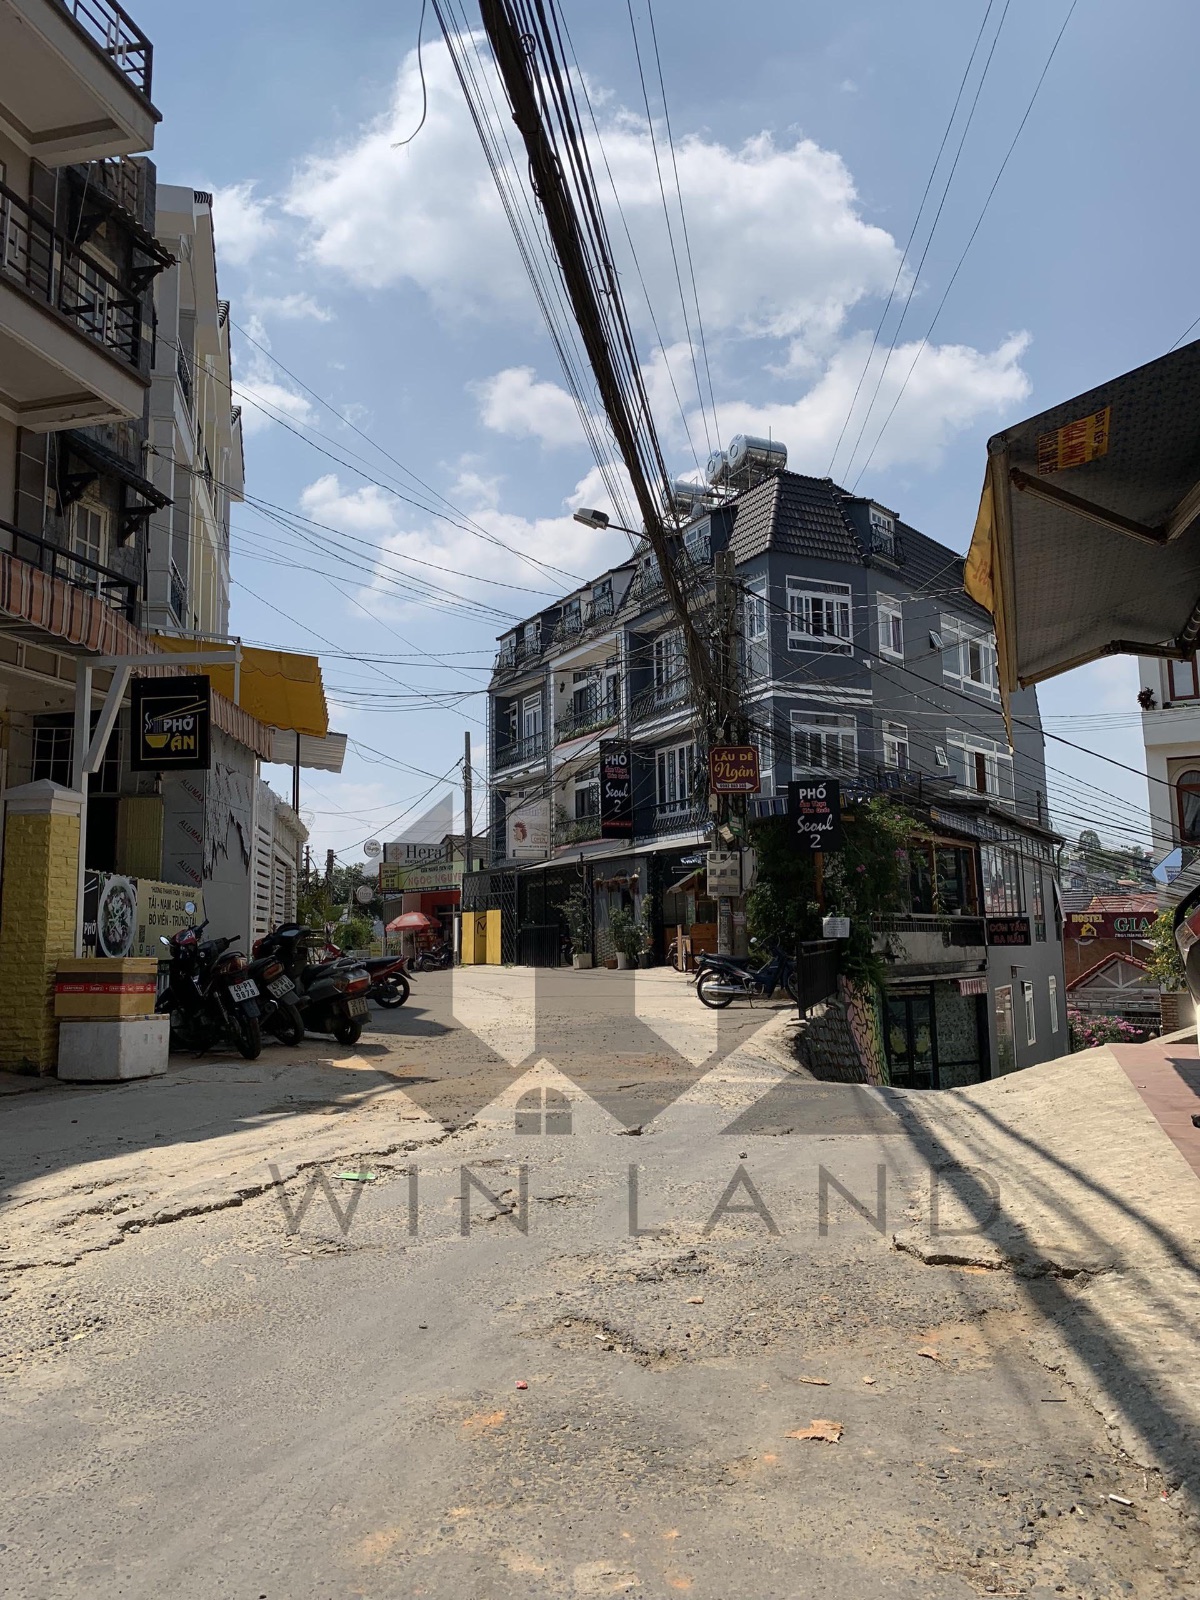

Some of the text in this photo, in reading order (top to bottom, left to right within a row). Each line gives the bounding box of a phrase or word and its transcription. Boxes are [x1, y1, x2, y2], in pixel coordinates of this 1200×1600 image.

[163, 715, 194, 732] PHỞ
[170, 733, 195, 751] ÂN
[739, 751, 753, 761] DÊ
[714, 762, 756, 783] Ngân
[605, 781, 628, 798] Seoul
[799, 782, 827, 800] PHỐ
[614, 799, 621, 813] 2
[797, 813, 834, 834] Seoul
[810, 834, 822, 849] 2
[406, 845, 442, 860] Hera
[408, 876, 432, 887] NGỌC
[1071, 914, 1105, 923] HOSTEL
[1113, 917, 1150, 932] GIA
[84, 920, 96, 936] PHỞ
